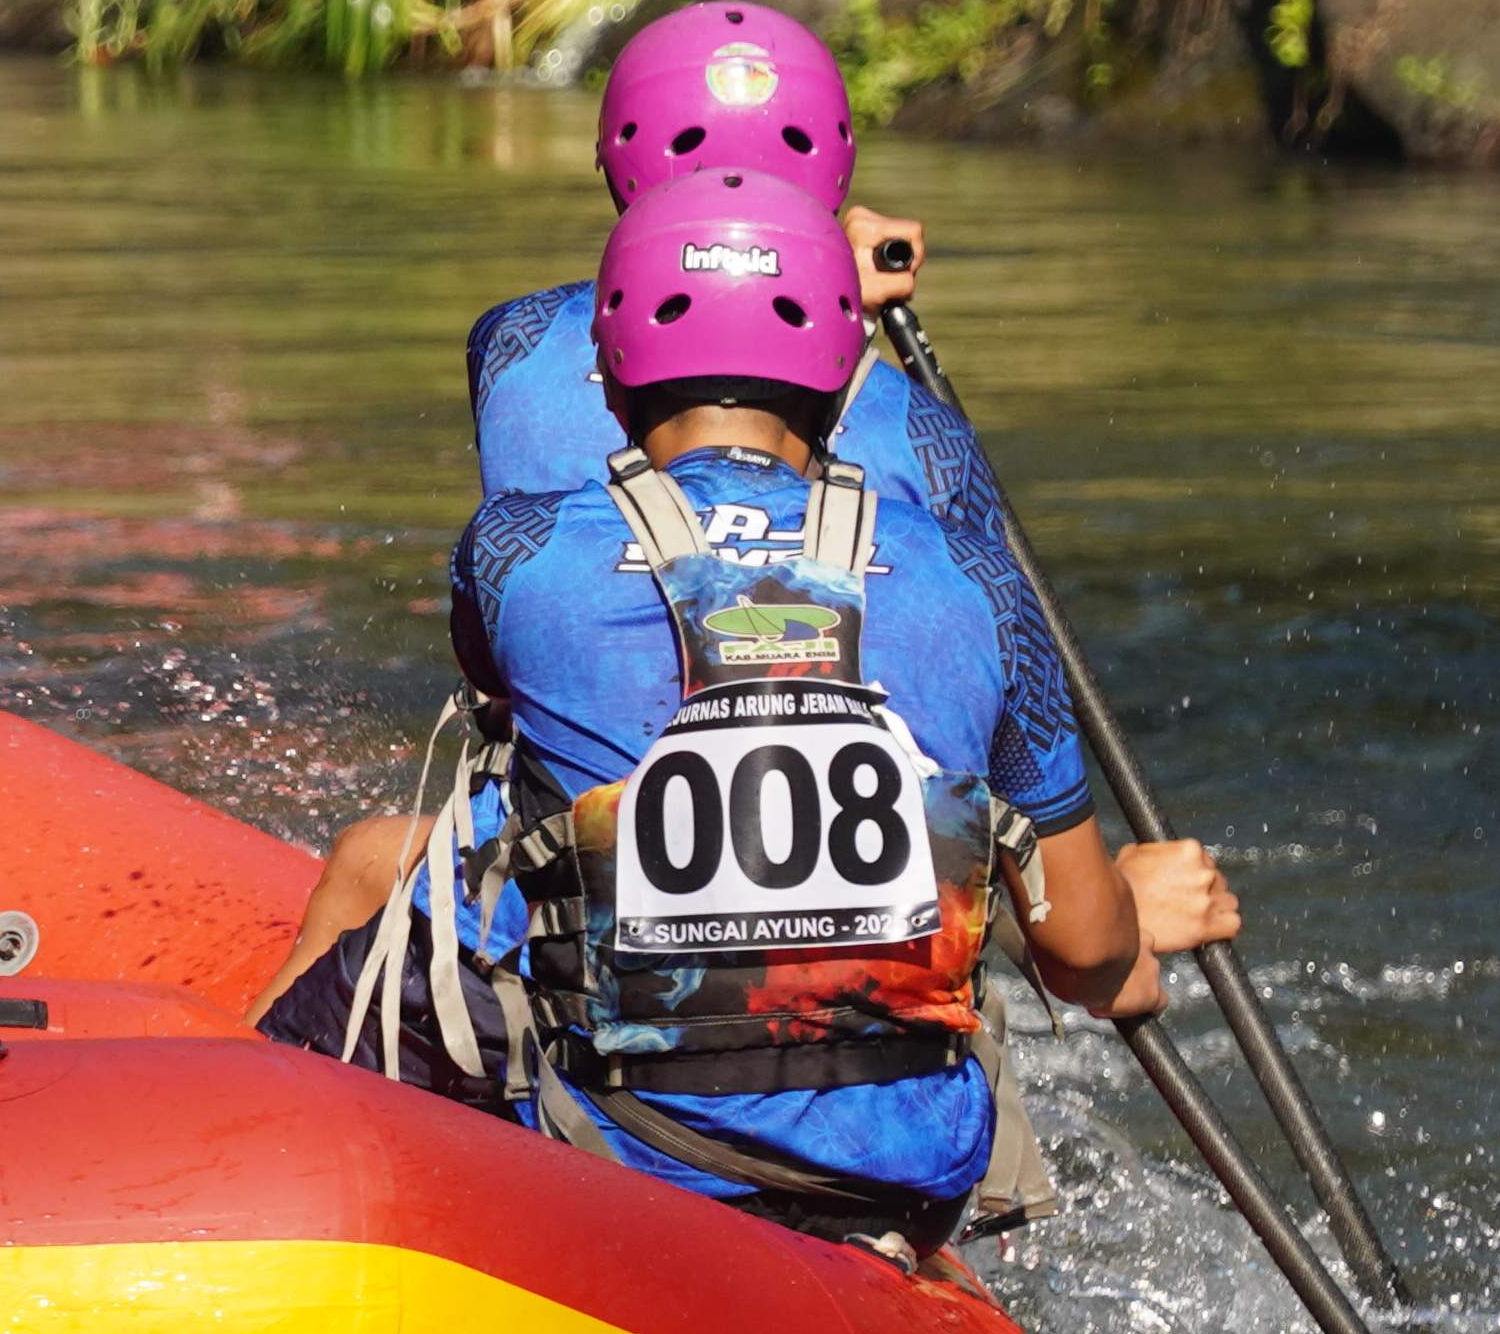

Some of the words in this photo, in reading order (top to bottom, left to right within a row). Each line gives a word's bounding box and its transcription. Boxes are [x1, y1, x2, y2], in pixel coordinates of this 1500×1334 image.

[735, 693, 795, 717] ARUNG
[800, 692, 849, 714] JERAM
[635, 742, 911, 895] 008
[653, 922, 748, 944] SUNGAI
[752, 916, 836, 940] AYUNG
